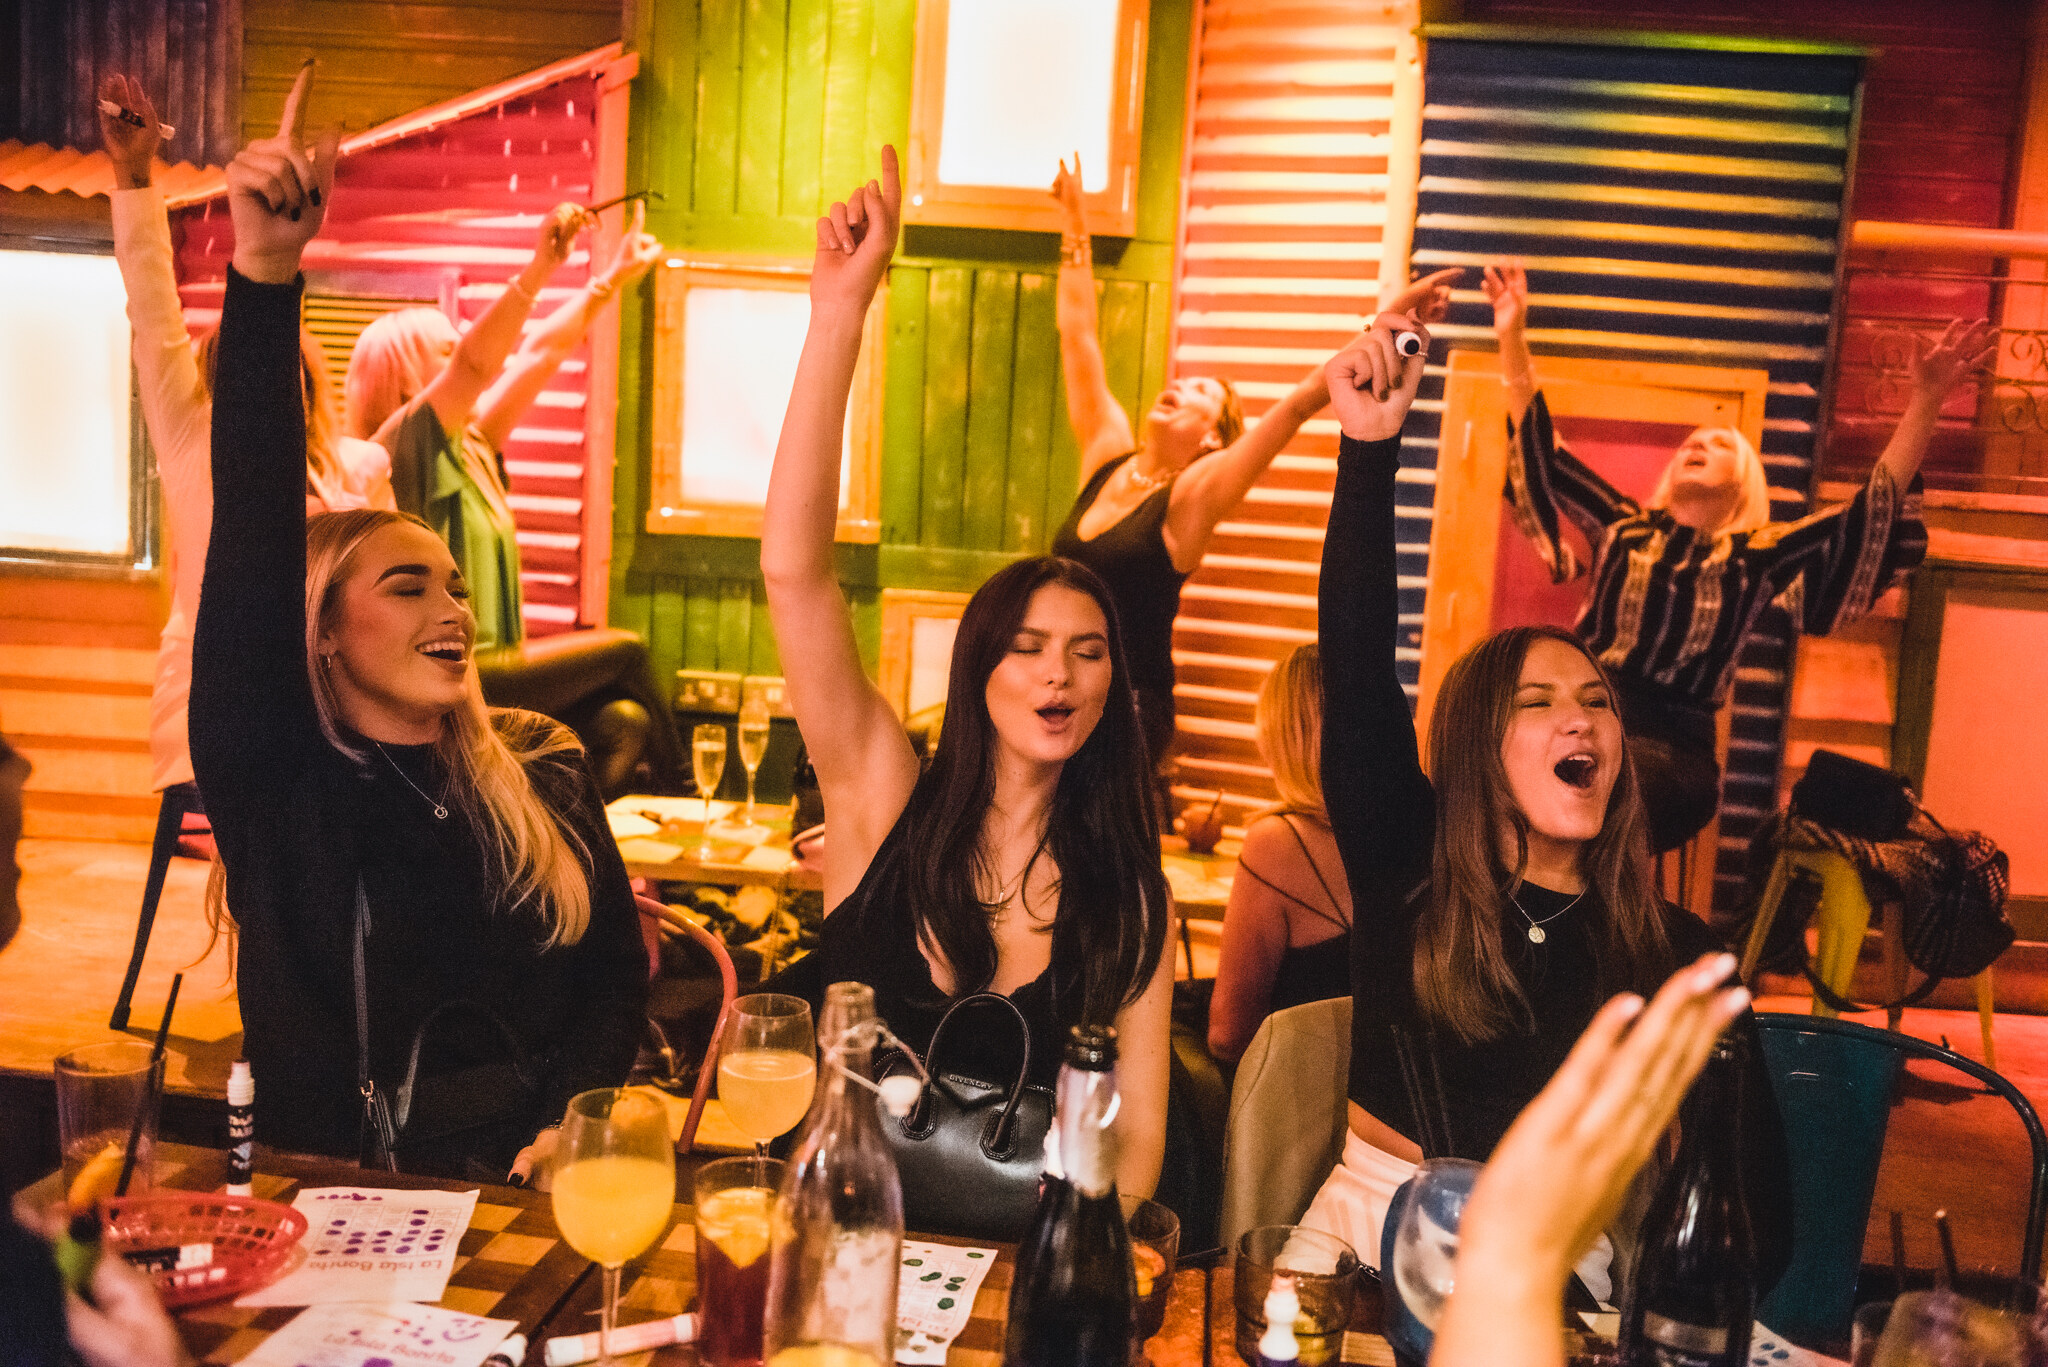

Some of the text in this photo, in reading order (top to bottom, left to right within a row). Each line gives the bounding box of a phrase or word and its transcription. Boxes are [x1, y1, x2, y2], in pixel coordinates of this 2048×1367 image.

[950, 1074, 993, 1090] GIVENCHY
[309, 1259, 443, 1271] La Isla Bonita
